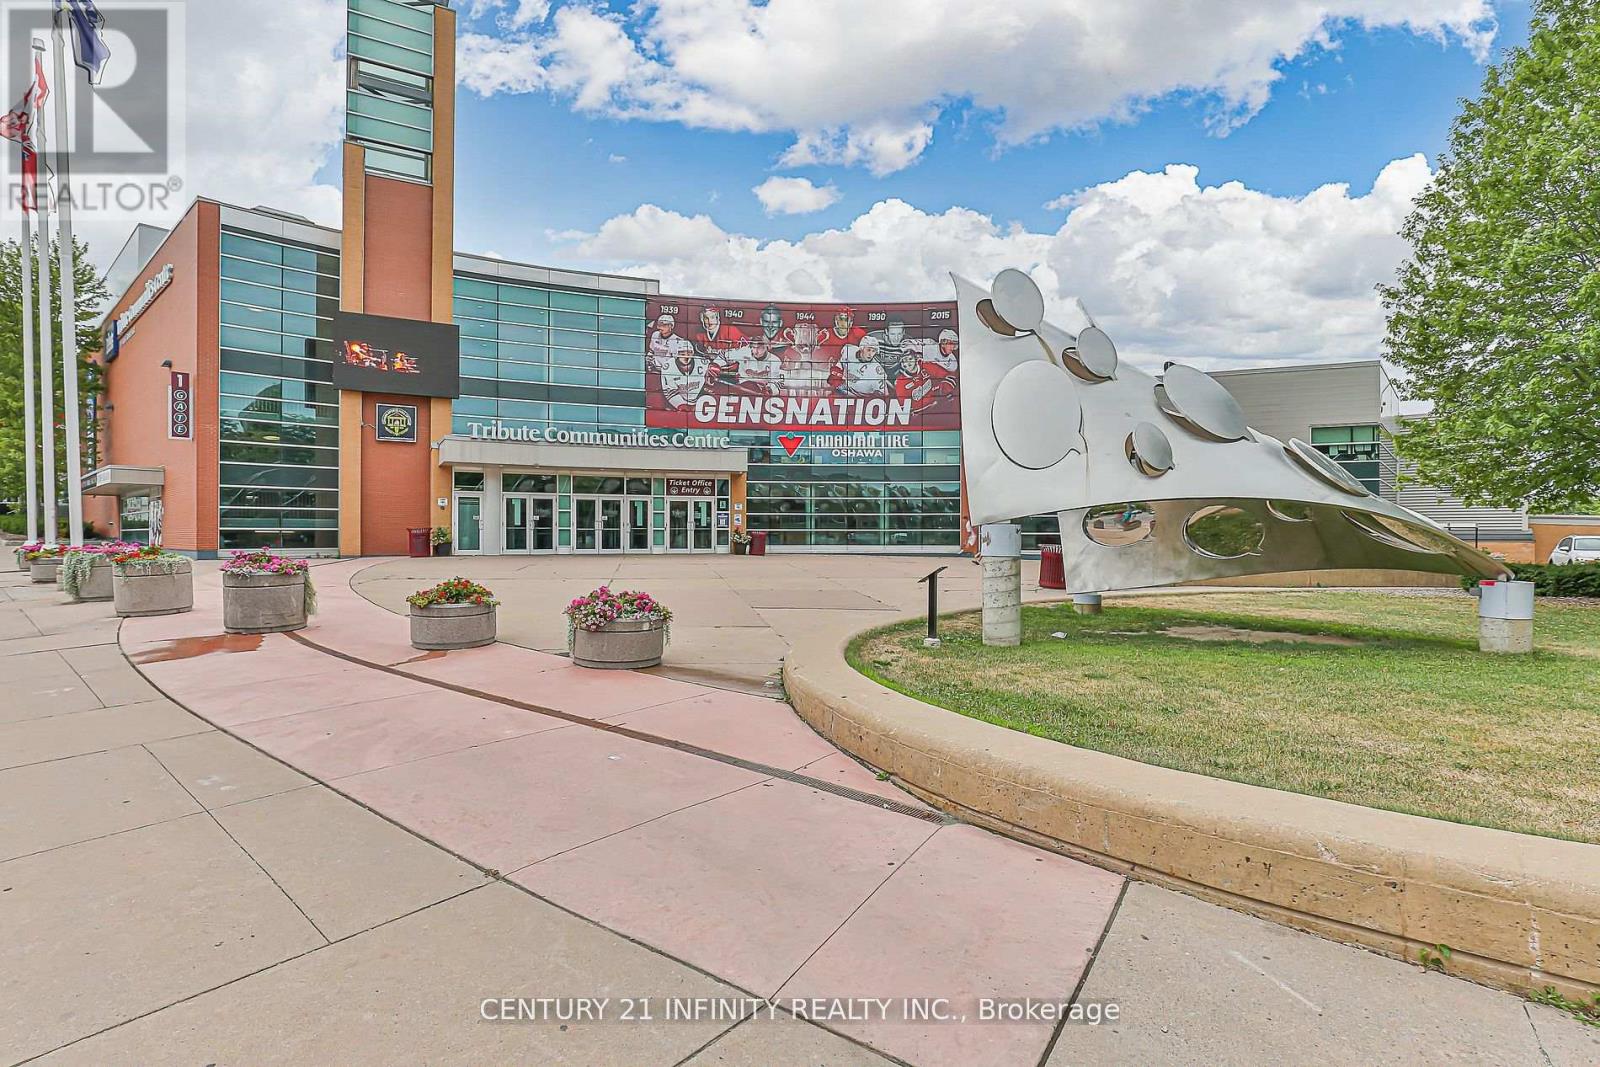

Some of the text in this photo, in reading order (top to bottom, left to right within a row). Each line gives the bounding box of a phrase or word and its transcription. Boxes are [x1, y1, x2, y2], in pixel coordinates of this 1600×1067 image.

[661, 305, 679, 314] 1939
[725, 309, 743, 318] 1940
[796, 312, 815, 320] 1944
[868, 312, 886, 321] 1990
[931, 311, 950, 320] 2015
[176, 374, 183, 388] 1
[175, 391, 185, 433] GATE
[694, 395, 912, 426] GENSNATION
[467, 420, 731, 449] Tribute Communities Centre
[808, 434, 876, 448] CANADIAN
[832, 448, 883, 458] OSHAWA
[669, 479, 713, 487] Ticket Office
[681, 486, 701, 495] Entry
